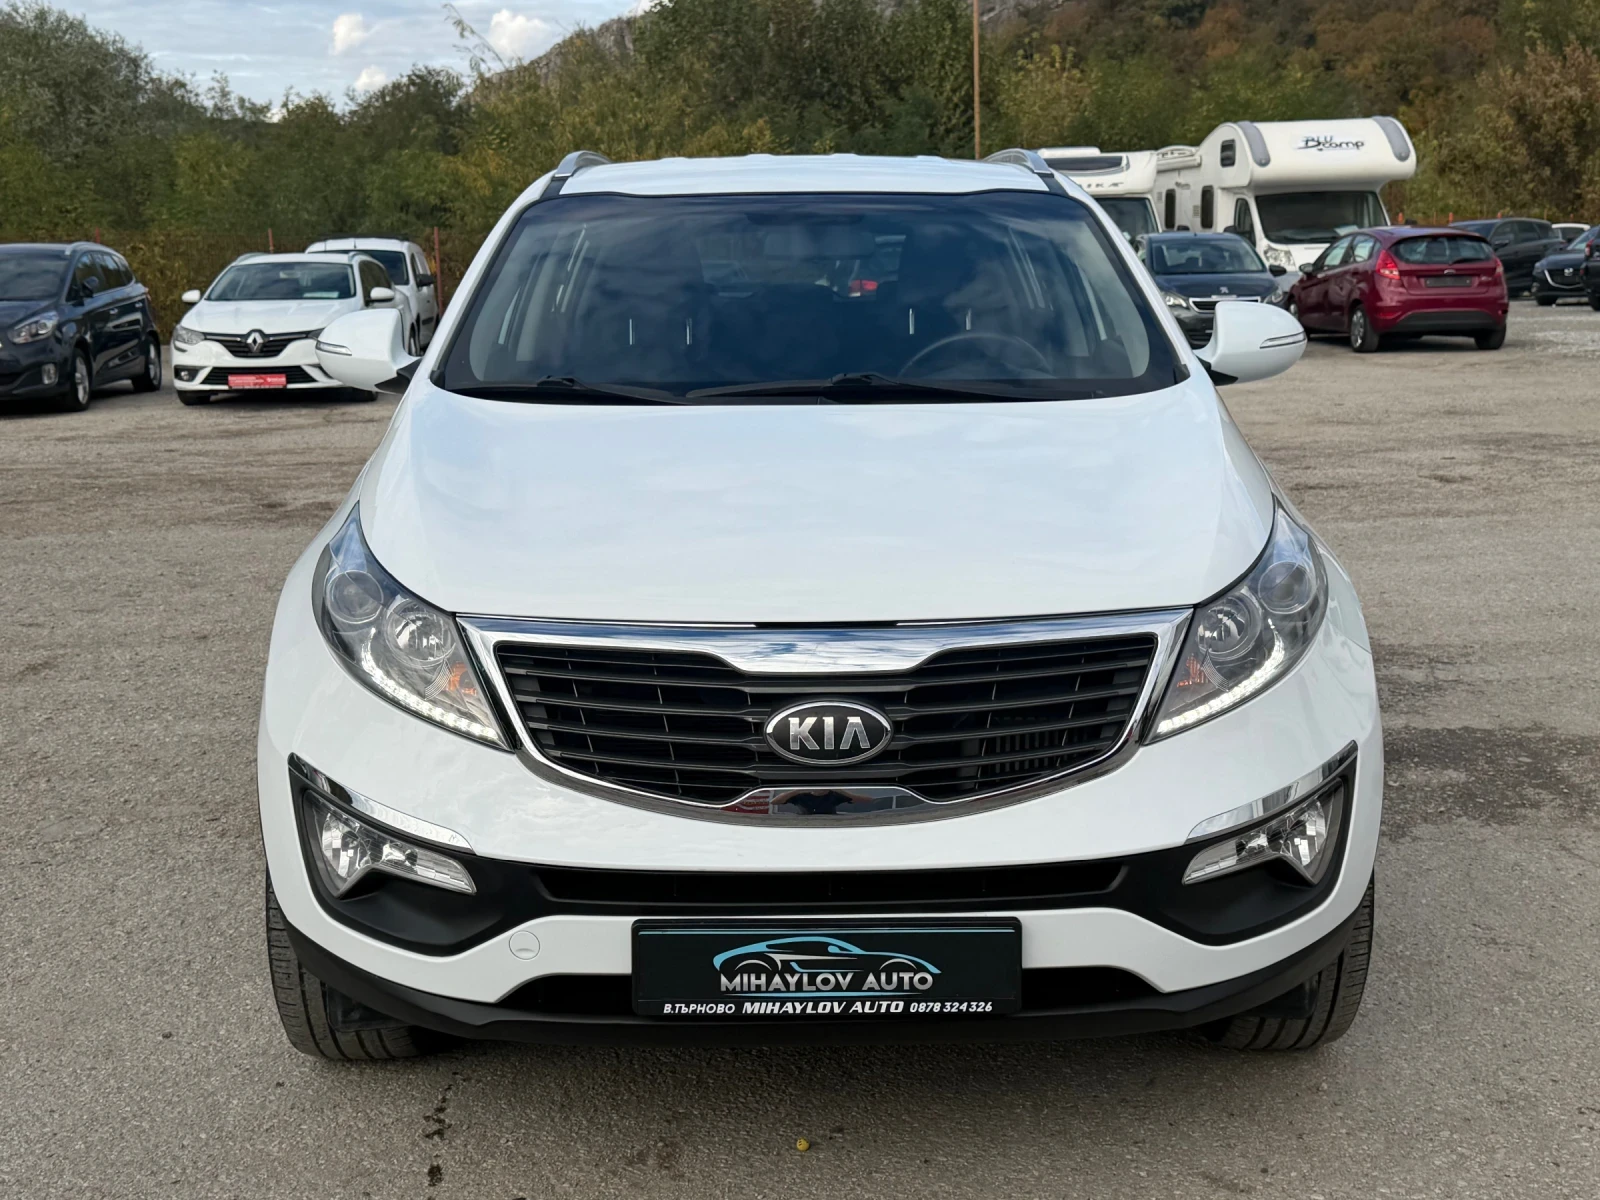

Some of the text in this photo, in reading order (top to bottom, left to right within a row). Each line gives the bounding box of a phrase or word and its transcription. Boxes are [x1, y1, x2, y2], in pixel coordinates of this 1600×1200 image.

[788, 716, 871, 750] KIA
[720, 971, 933, 991] MIHAYLOV AUTO
[663, 1001, 993, 1014] В.ТЪРНОВО MIHAYLOV AUTO 0878 324 326
